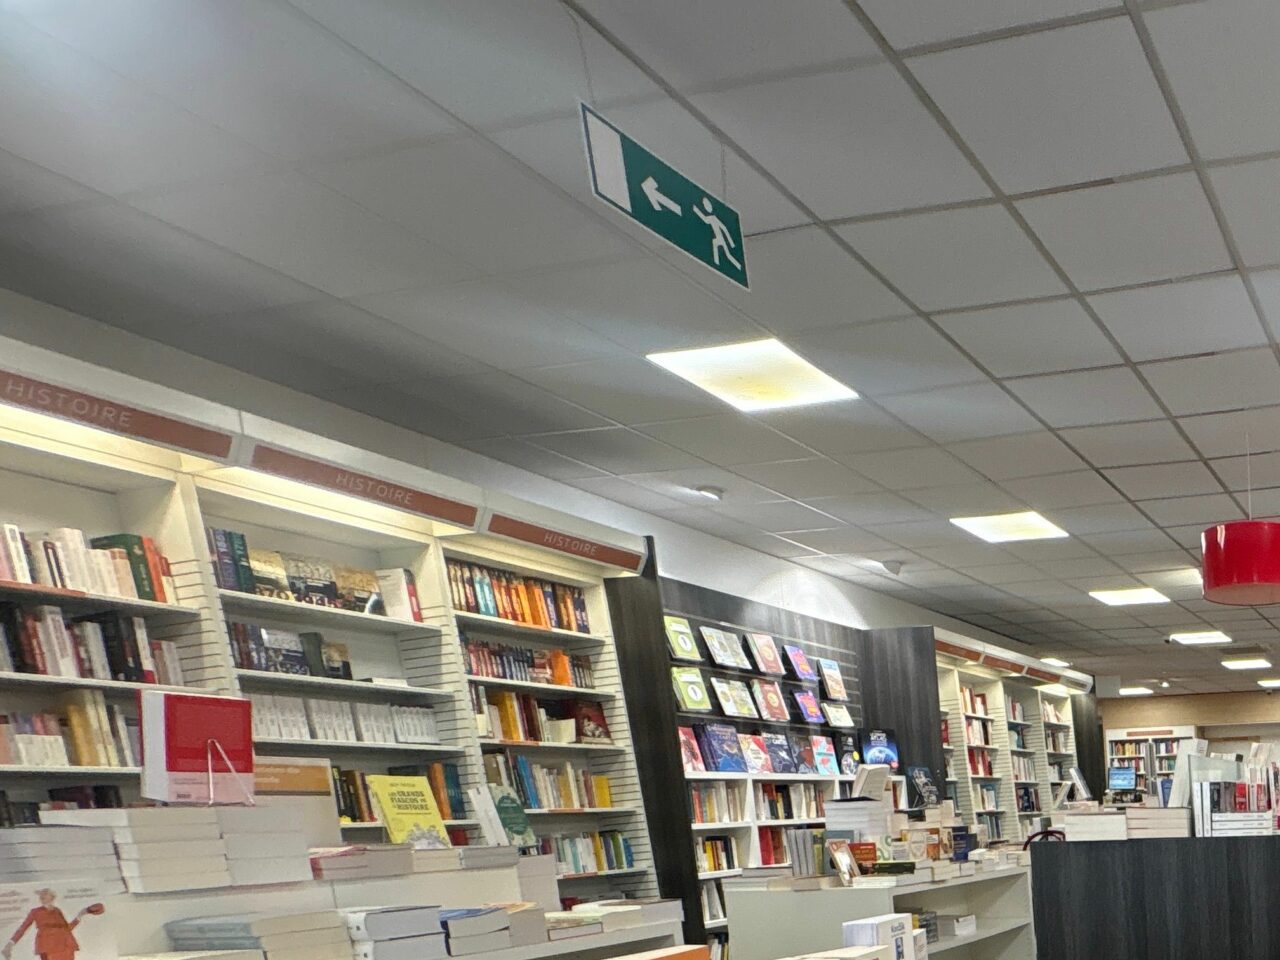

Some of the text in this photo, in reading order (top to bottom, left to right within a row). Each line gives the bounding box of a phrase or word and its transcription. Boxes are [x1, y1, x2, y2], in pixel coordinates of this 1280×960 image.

[5, 379, 132, 428] HISTOIRE
[336, 473, 414, 505] HISTOIRE
[543, 531, 598, 556] HISTOIRE
